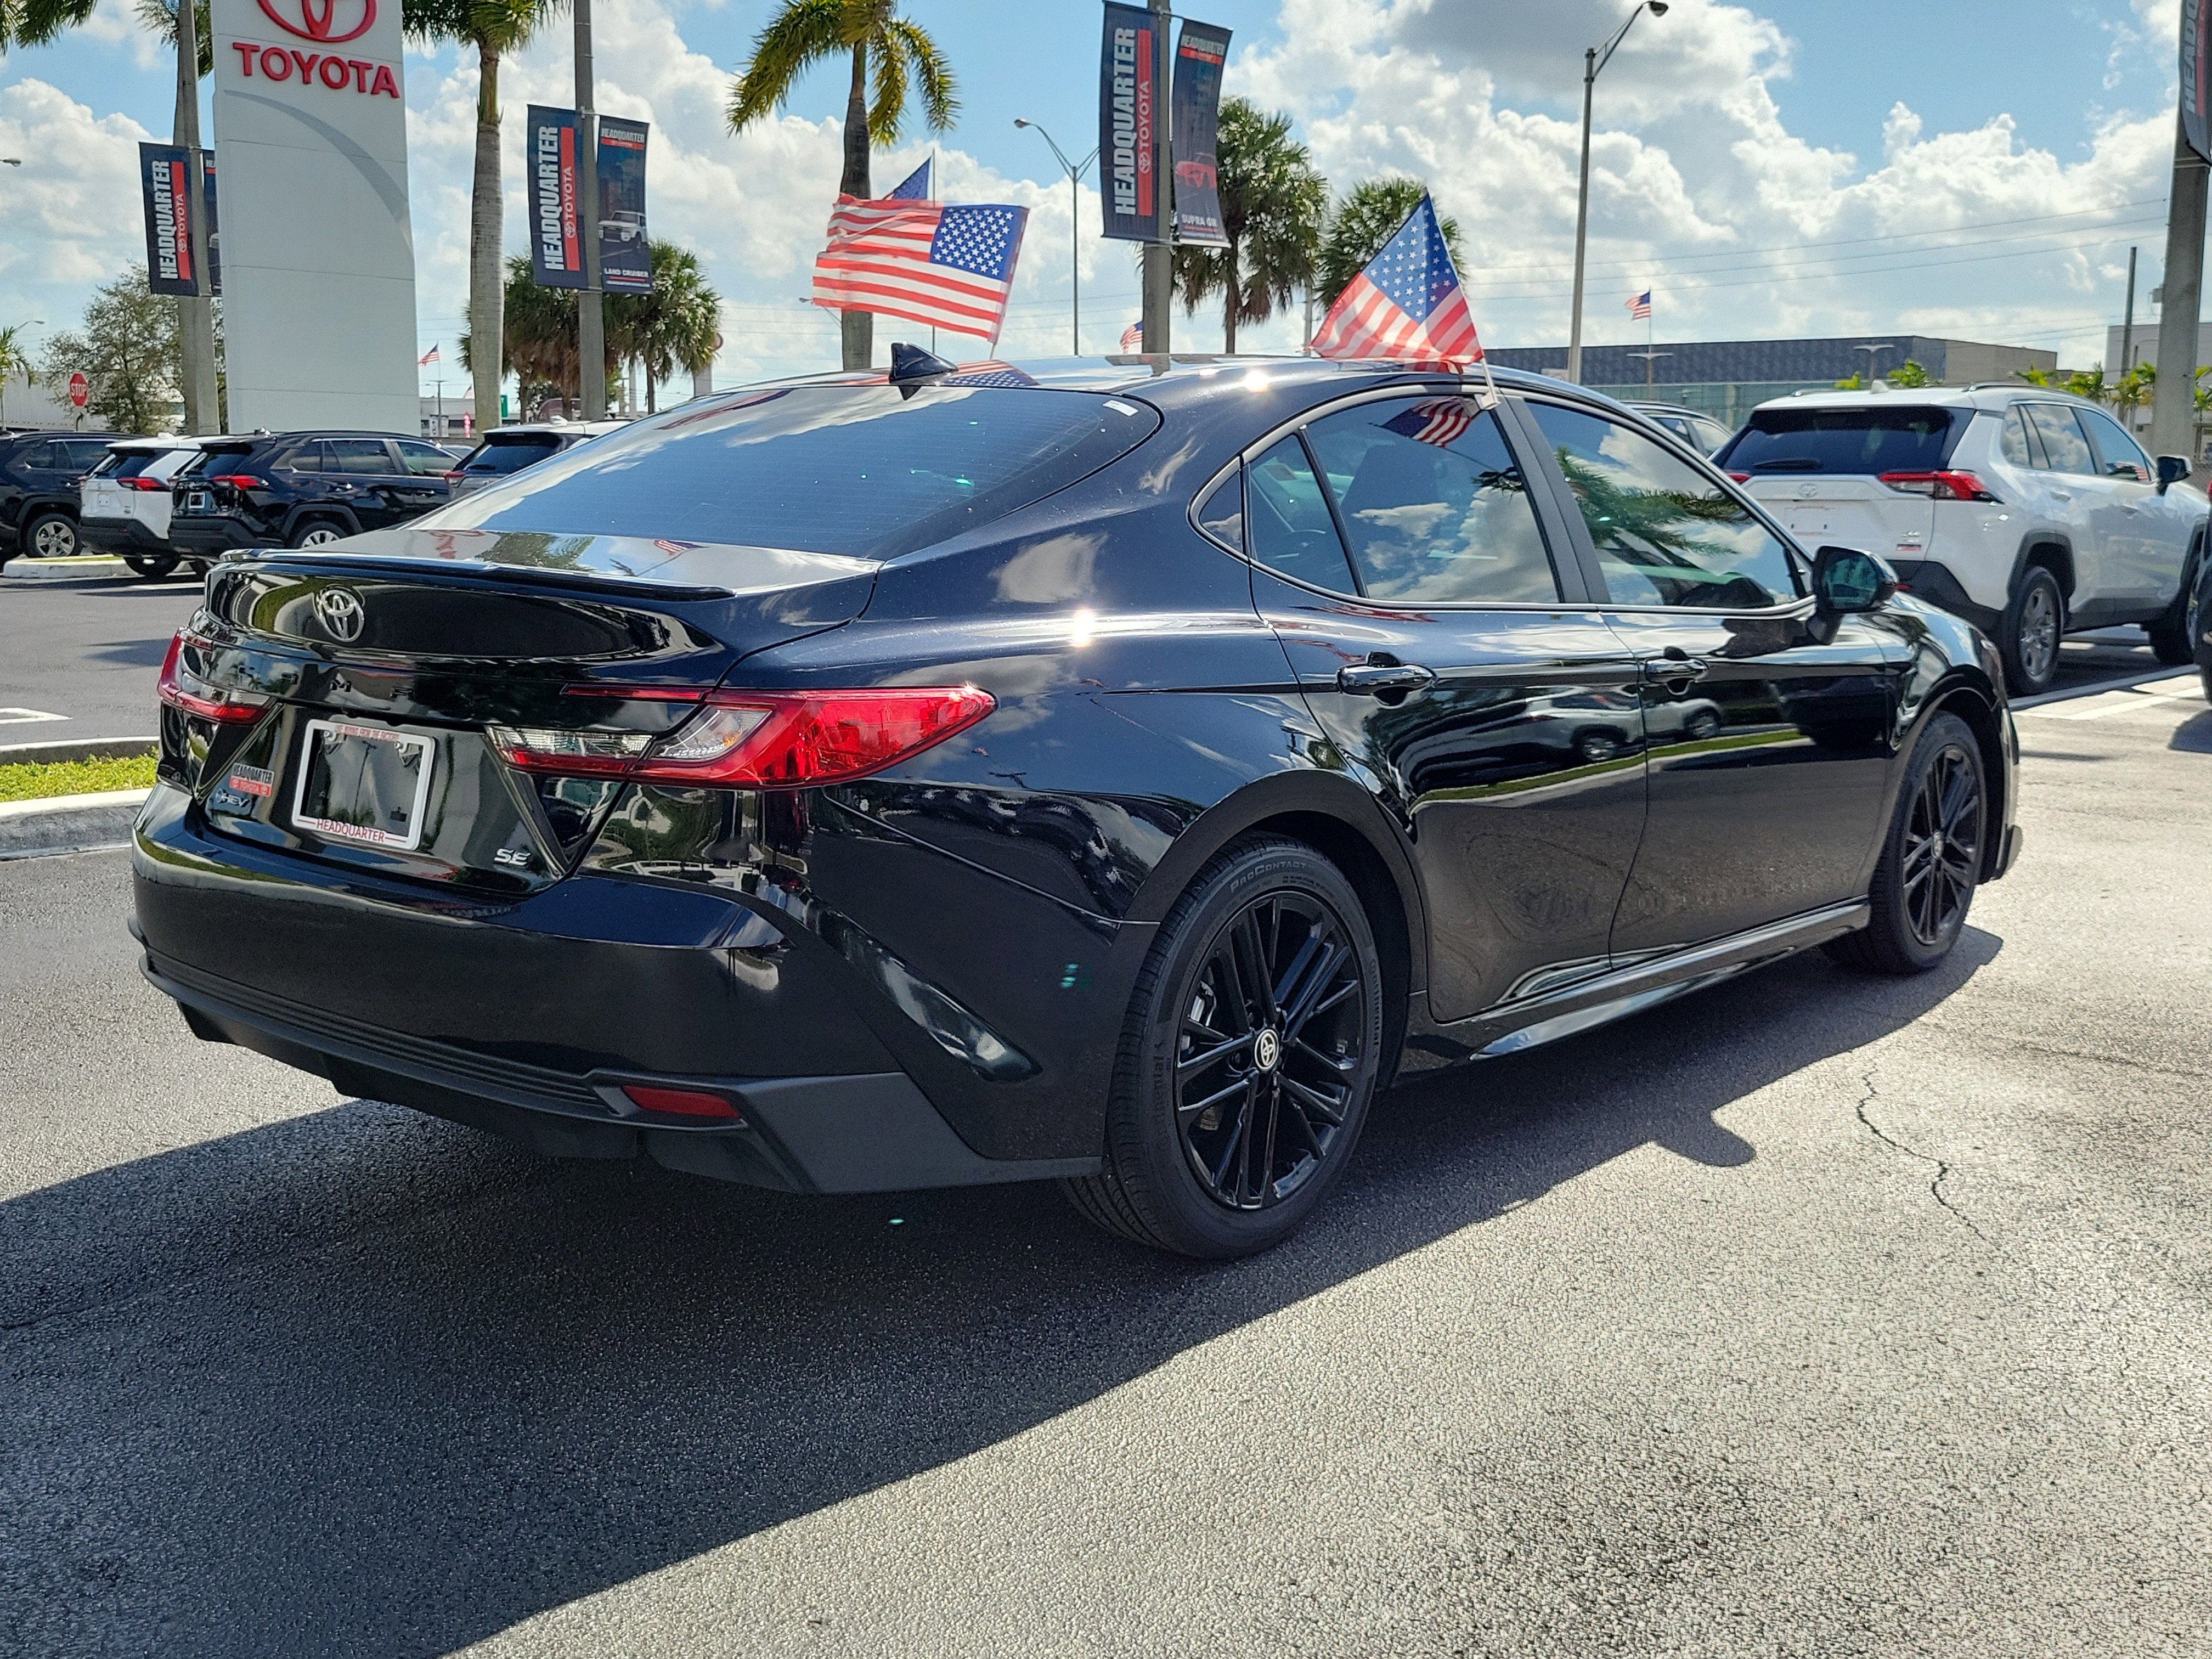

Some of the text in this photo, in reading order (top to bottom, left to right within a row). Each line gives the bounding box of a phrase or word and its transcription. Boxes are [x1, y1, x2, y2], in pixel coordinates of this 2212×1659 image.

[233, 42, 400, 99] TOYOTA
[1113, 27, 1137, 215] HEADQUARTER
[1139, 81, 1150, 149] TOYOTA
[539, 126, 565, 270] HEADQUARTER
[563, 166, 574, 220] TOYOTA
[153, 160, 178, 279] HEADQUARTER
[176, 194, 185, 236] TOYOTA
[71, 382, 87, 397] STOP
[233, 764, 273, 785] HEADQUARTER
[240, 781, 259, 792] TOYOTA
[223, 793, 250, 808] HEV
[317, 819, 385, 843] HEADQUARTER
[494, 848, 531, 866] SE
